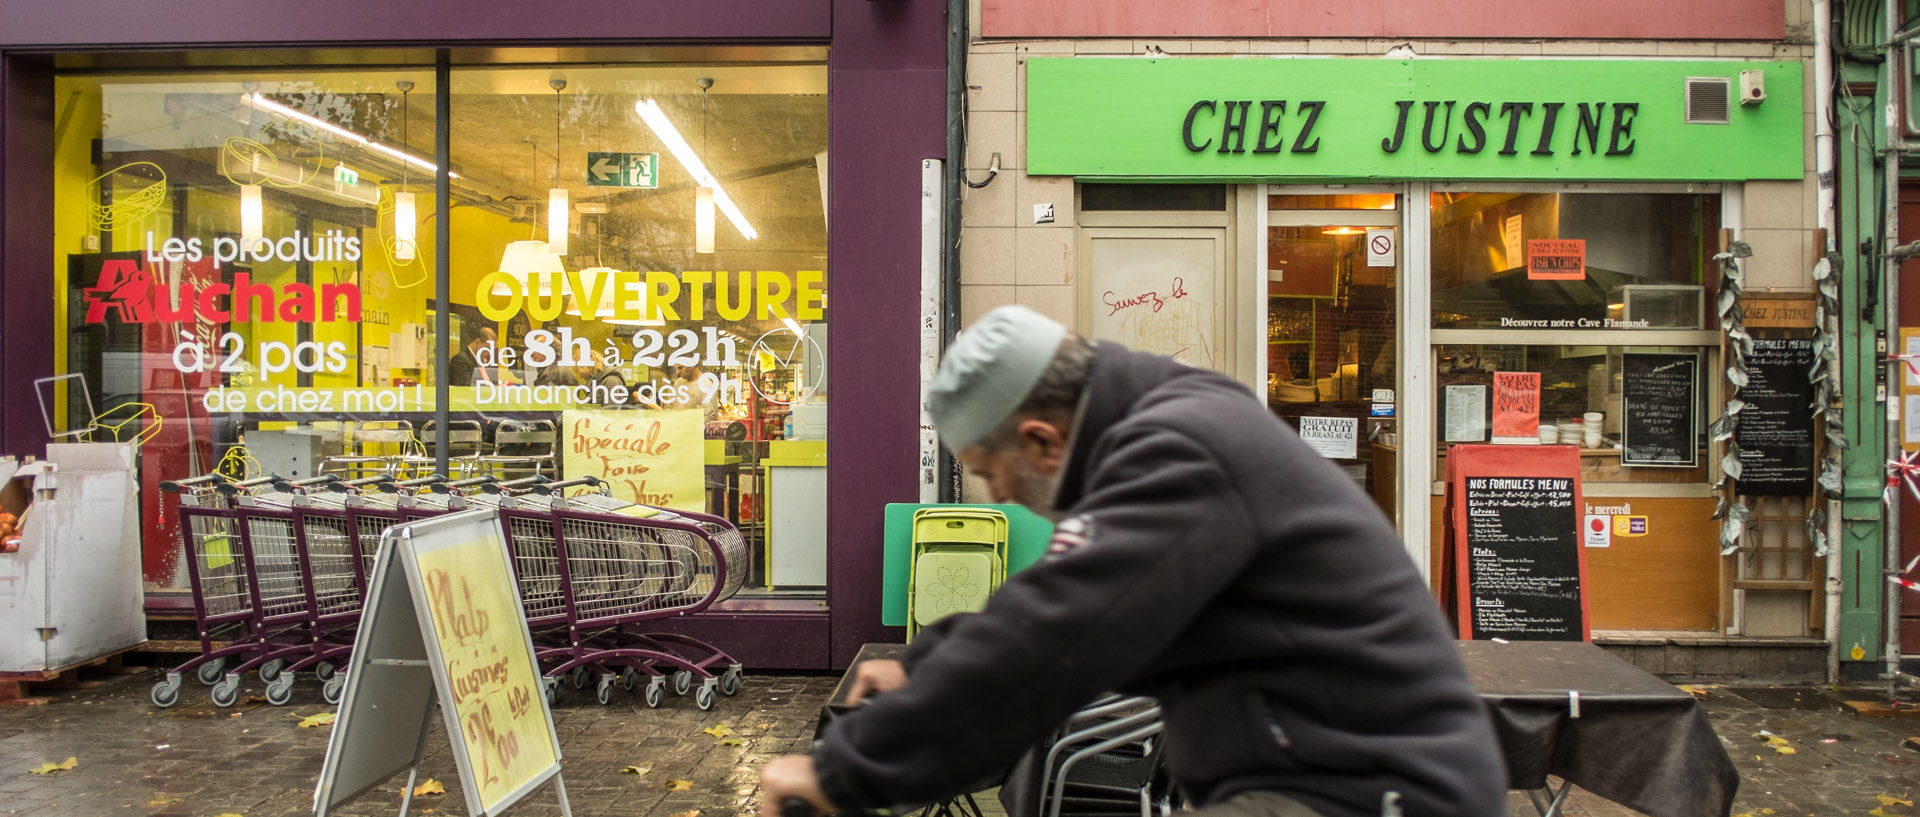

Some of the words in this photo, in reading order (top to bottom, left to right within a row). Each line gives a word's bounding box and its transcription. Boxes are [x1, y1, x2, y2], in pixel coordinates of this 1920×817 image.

[1183, 99, 1326, 153] CHEZ
[1381, 100, 1639, 155] JUSTINE
[147, 231, 203, 262] Les
[213, 231, 361, 268] produits
[1532, 257, 1548, 268] FISH
[1558, 257, 1580, 268] CHIPS
[83, 259, 361, 323] Auchan
[475, 271, 823, 321] OUVERTURE
[1744, 306, 1767, 319] CHEZ
[1772, 308, 1808, 319] JUSTINE
[1501, 317, 1548, 327] Découvrez
[1551, 318, 1575, 327] notre
[1578, 318, 1600, 327] Cave
[1604, 318, 1649, 328] Flamande
[476, 340, 517, 367] de
[523, 327, 595, 367] 8h
[603, 338, 624, 367] à
[632, 327, 740, 367] 22h
[1788, 340, 1811, 349] MENU
[173, 330, 204, 373] à
[219, 332, 245, 372] 2
[260, 339, 347, 381] pas
[1499, 374, 1536, 382] VOTRE
[476, 376, 629, 404] Dimanche
[638, 376, 689, 404] dès
[698, 372, 742, 404] 9h
[1499, 381, 1536, 390] REPAS
[203, 385, 247, 413] de
[256, 385, 334, 413] chez
[343, 385, 404, 412] moi
[416, 385, 422, 411] !
[1302, 417, 1330, 427] VOTRE
[1330, 419, 1353, 428] REPAS
[1303, 424, 1352, 432] GRATUIT
[573, 417, 671, 459] Spéciale
[1311, 431, 1334, 439] JOUANT
[1470, 479, 1487, 489] NOS
[1489, 479, 1535, 490] FORMULES
[1538, 479, 1568, 490] MENU
[1585, 503, 1593, 514] le
[1595, 503, 1630, 515] mercredi
